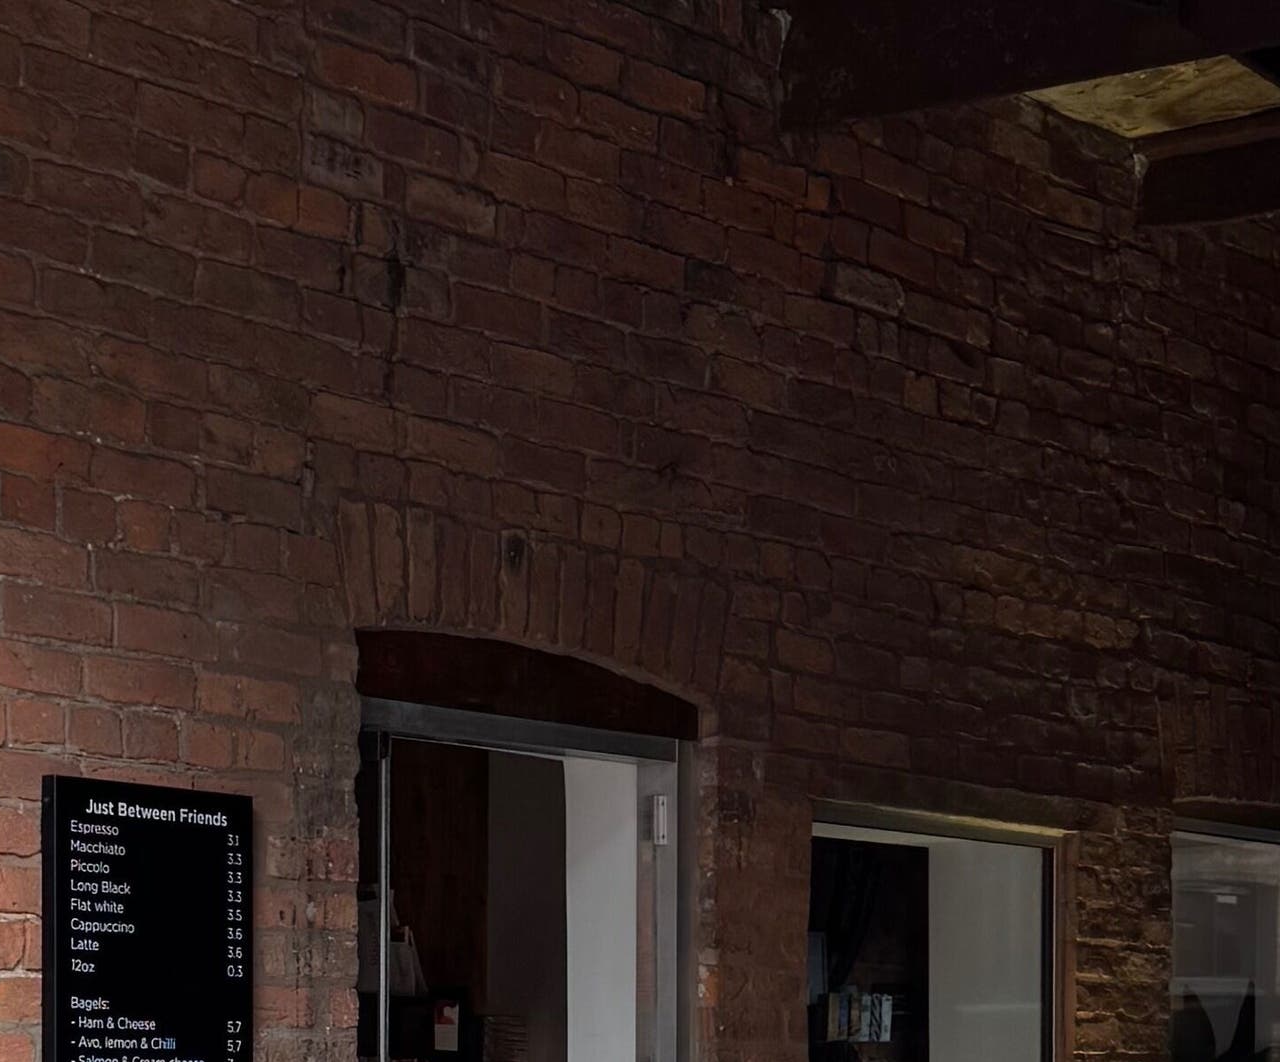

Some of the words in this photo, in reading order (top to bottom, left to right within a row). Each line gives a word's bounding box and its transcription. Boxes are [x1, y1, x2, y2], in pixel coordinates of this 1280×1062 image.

[85, 798, 115, 816] Just
[117, 801, 176, 822] Between
[179, 808, 228, 827] Friends
[70, 819, 119, 836] Espresso
[70, 839, 126, 856] Macchiato
[70, 858, 110, 874] Piccolo
[70, 878, 99, 895] Long
[101, 880, 131, 895] Black
[70, 897, 92, 912] Flat
[94, 900, 124, 914] white
[70, 917, 135, 934] Cappuccino
[70, 937, 100, 951] Latte
[71, 958, 95, 973] 12oz
[78, 1015, 104, 1029] Ham
[106, 1016, 115, 1030] &
[117, 1016, 156, 1031] Cheese
[104, 1036, 138, 1050] lemon
[140, 1037, 149, 1050] &
[150, 1037, 176, 1050] Chilli
